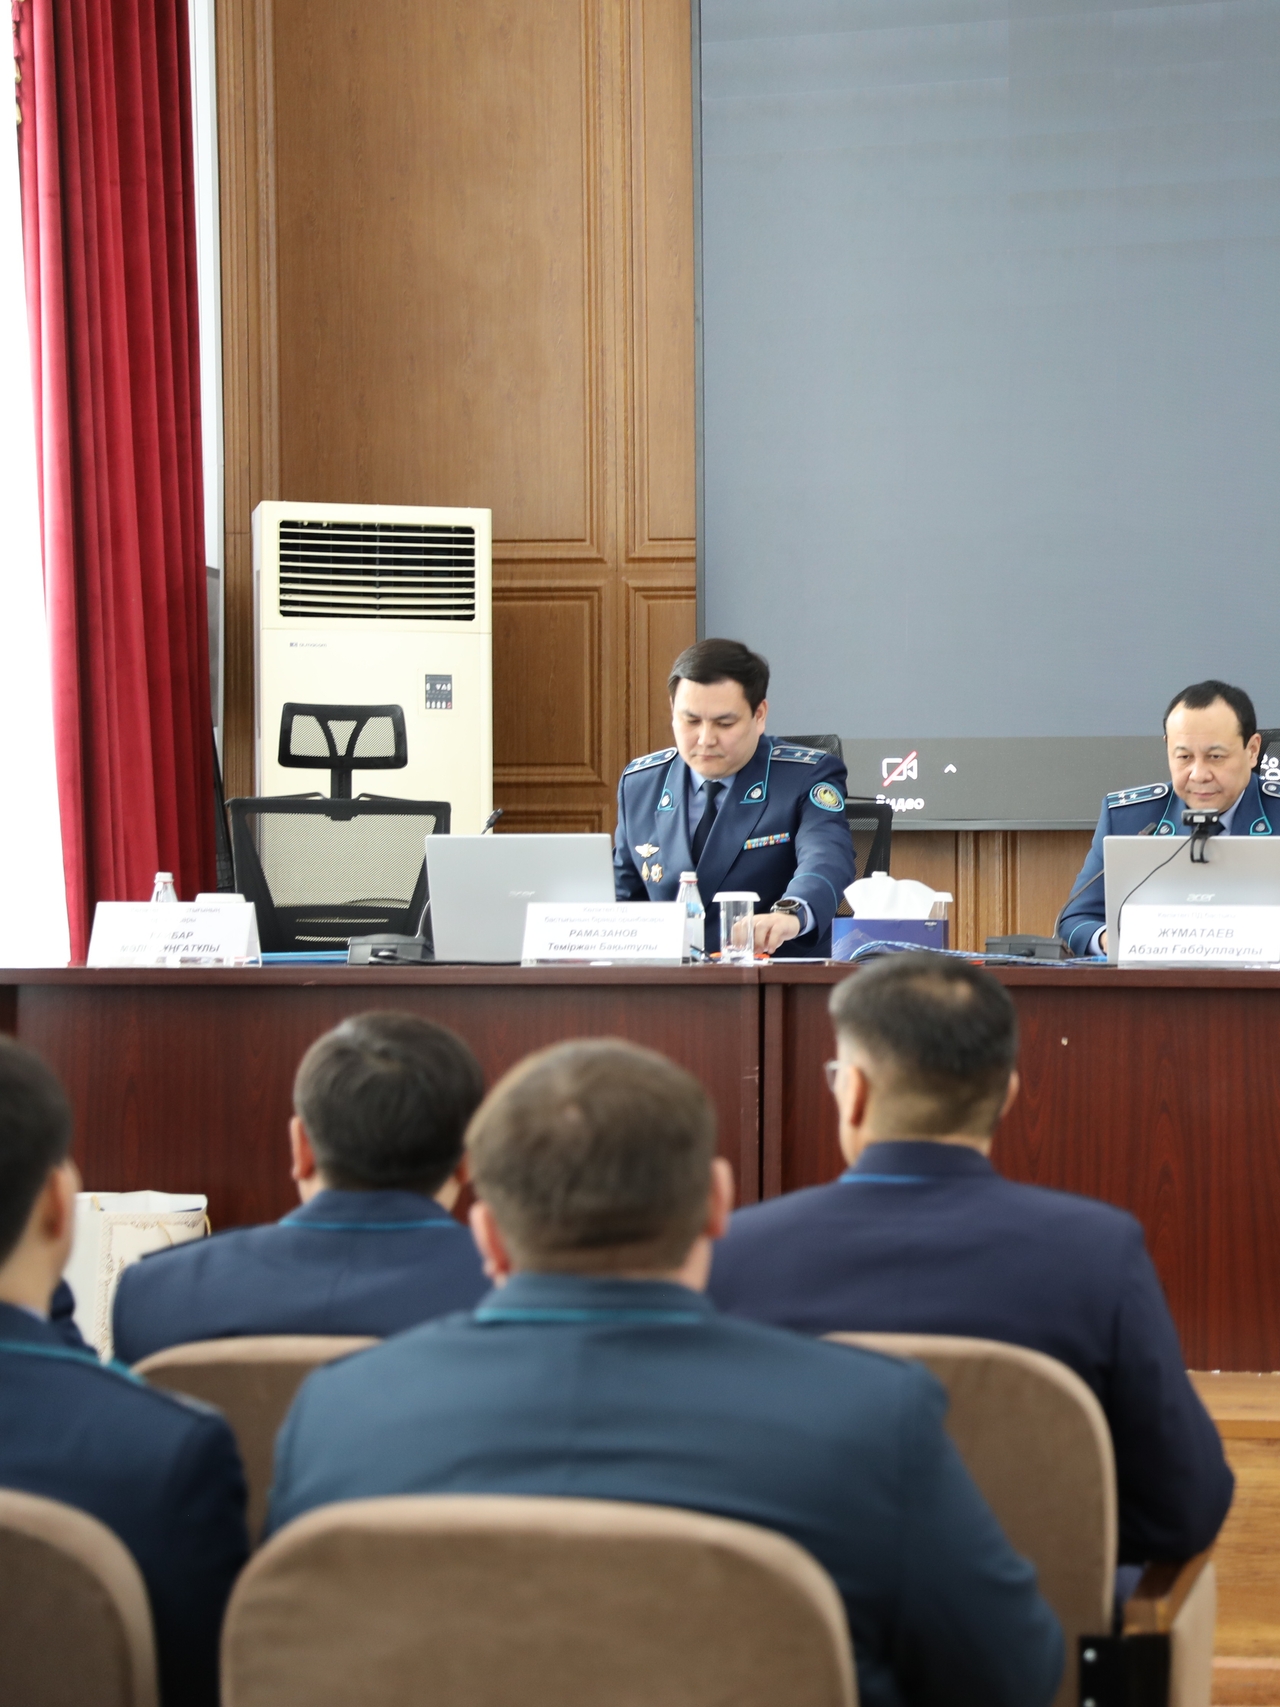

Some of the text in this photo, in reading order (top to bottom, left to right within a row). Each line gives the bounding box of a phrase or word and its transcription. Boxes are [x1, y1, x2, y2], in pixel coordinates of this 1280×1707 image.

[1186, 893, 1216, 902] acer
[568, 928, 638, 938] РАМАЗАНОВ
[1157, 928, 1235, 938] ЖҰМАТАЕВ
[1127, 944, 1169, 955] Абзал
